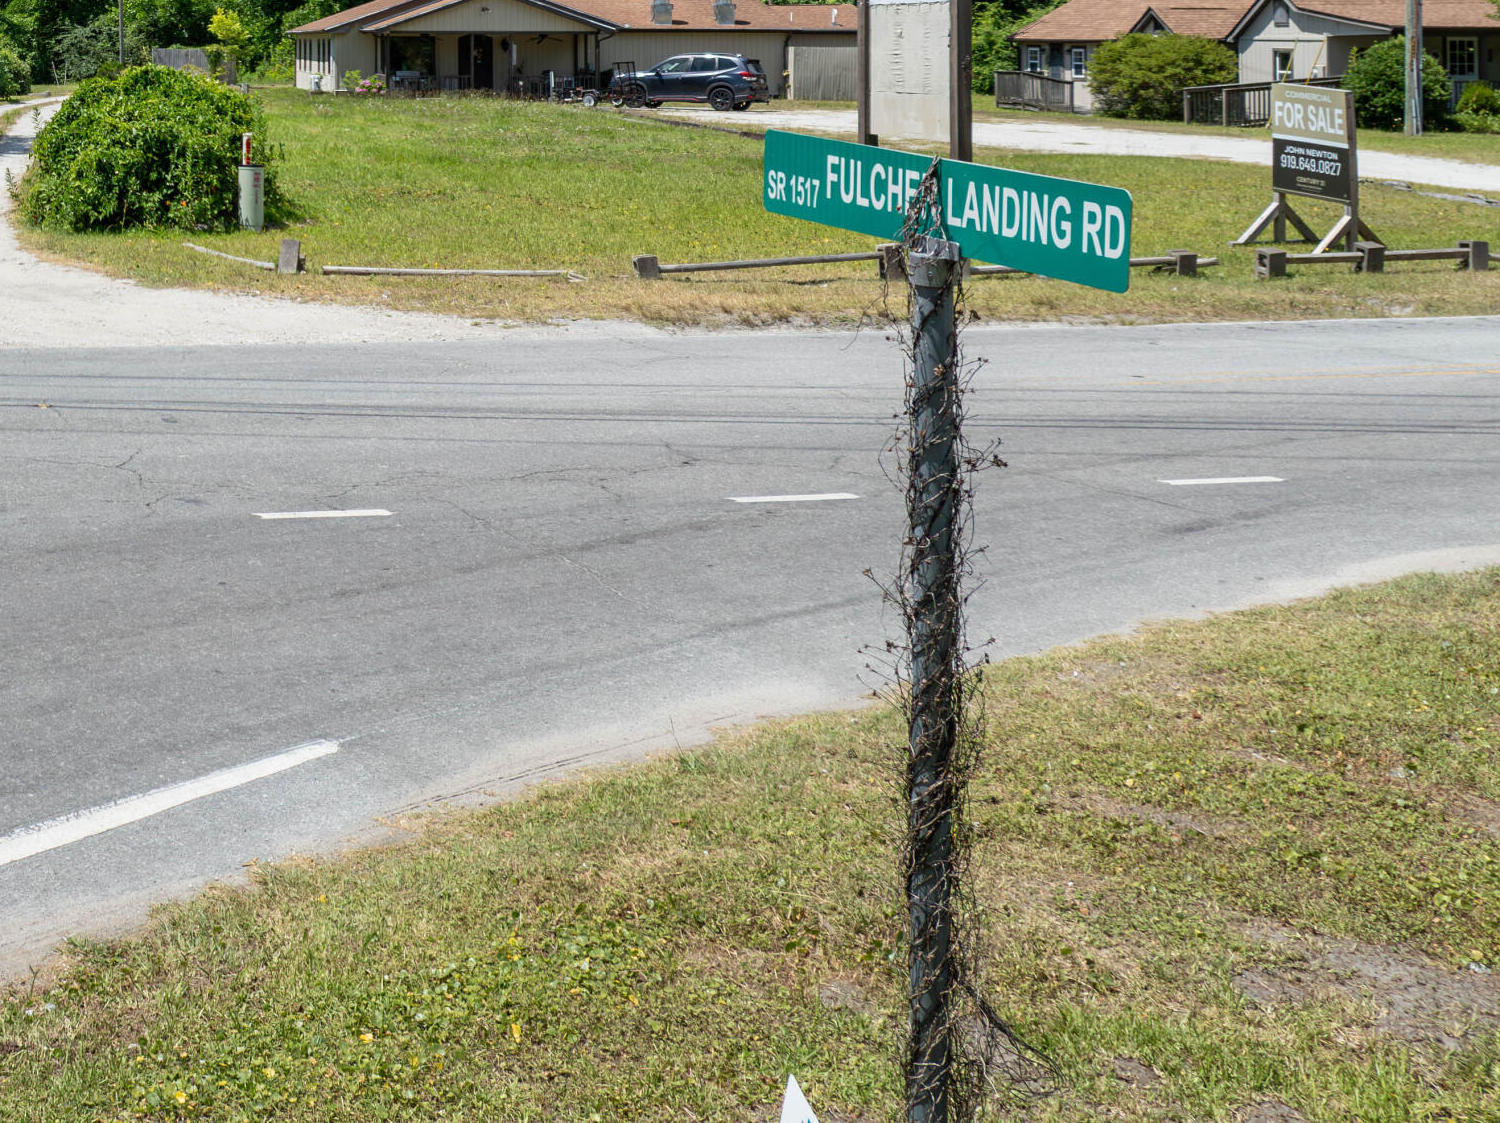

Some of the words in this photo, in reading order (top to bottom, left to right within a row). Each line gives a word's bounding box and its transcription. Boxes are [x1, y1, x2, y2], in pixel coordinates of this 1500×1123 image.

[1285, 90, 1332, 103] COMMERCIAL
[1274, 100, 1306, 131] FOR
[1307, 104, 1344, 135] SALE
[1284, 145, 1305, 155] JOHN
[1305, 147, 1338, 160] NEWTON
[1280, 154, 1342, 176] 919.649.0827
[767, 169, 786, 201] SR
[790, 175, 820, 209] 1517
[826, 154, 940, 225] FULCHE
[947, 177, 1072, 250] LANDING
[1081, 200, 1125, 260] RD
